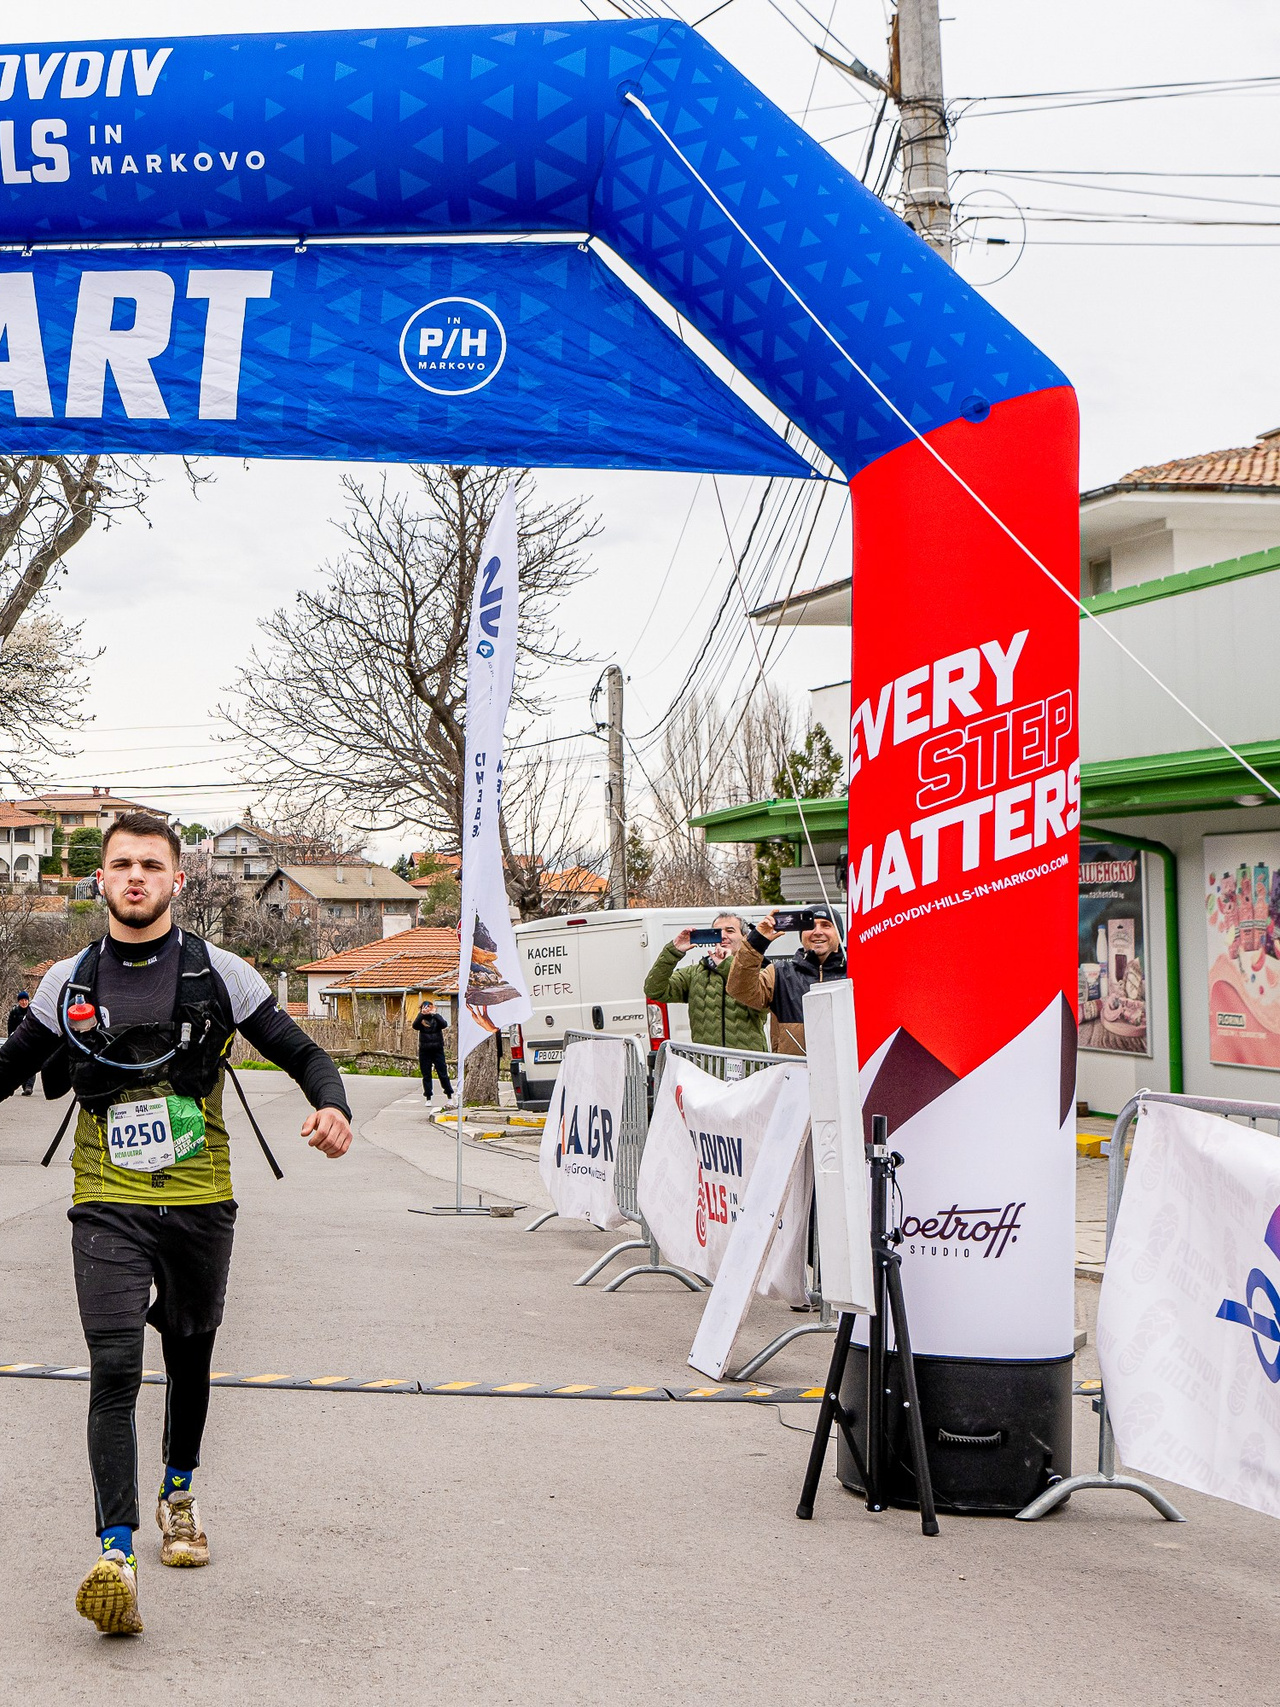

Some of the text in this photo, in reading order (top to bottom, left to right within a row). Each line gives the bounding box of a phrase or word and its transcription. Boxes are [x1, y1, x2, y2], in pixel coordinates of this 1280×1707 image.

[90, 124, 122, 145] IN
[91, 151, 266, 175] MARKOVO
[447, 317, 461, 325] IN
[420, 327, 488, 358] P/H
[418, 361, 487, 372] MARKOVO
[850, 628, 1030, 786] EVERY
[916, 689, 1073, 811] STEP
[848, 757, 1080, 932] MATTERS
[859, 853, 1069, 944] WWW.PLOVDIV-HILLS-IN-MARKOVO.COM
[527, 945, 568, 960] KACHEL
[534, 963, 562, 976] ÖFEN
[530, 982, 573, 998] EITER
[612, 1014, 644, 1022] DUCATO
[111, 1120, 167, 1149] 4250
[729, 1192, 739, 1206] IN
[910, 1244, 970, 1258] STUDIO
